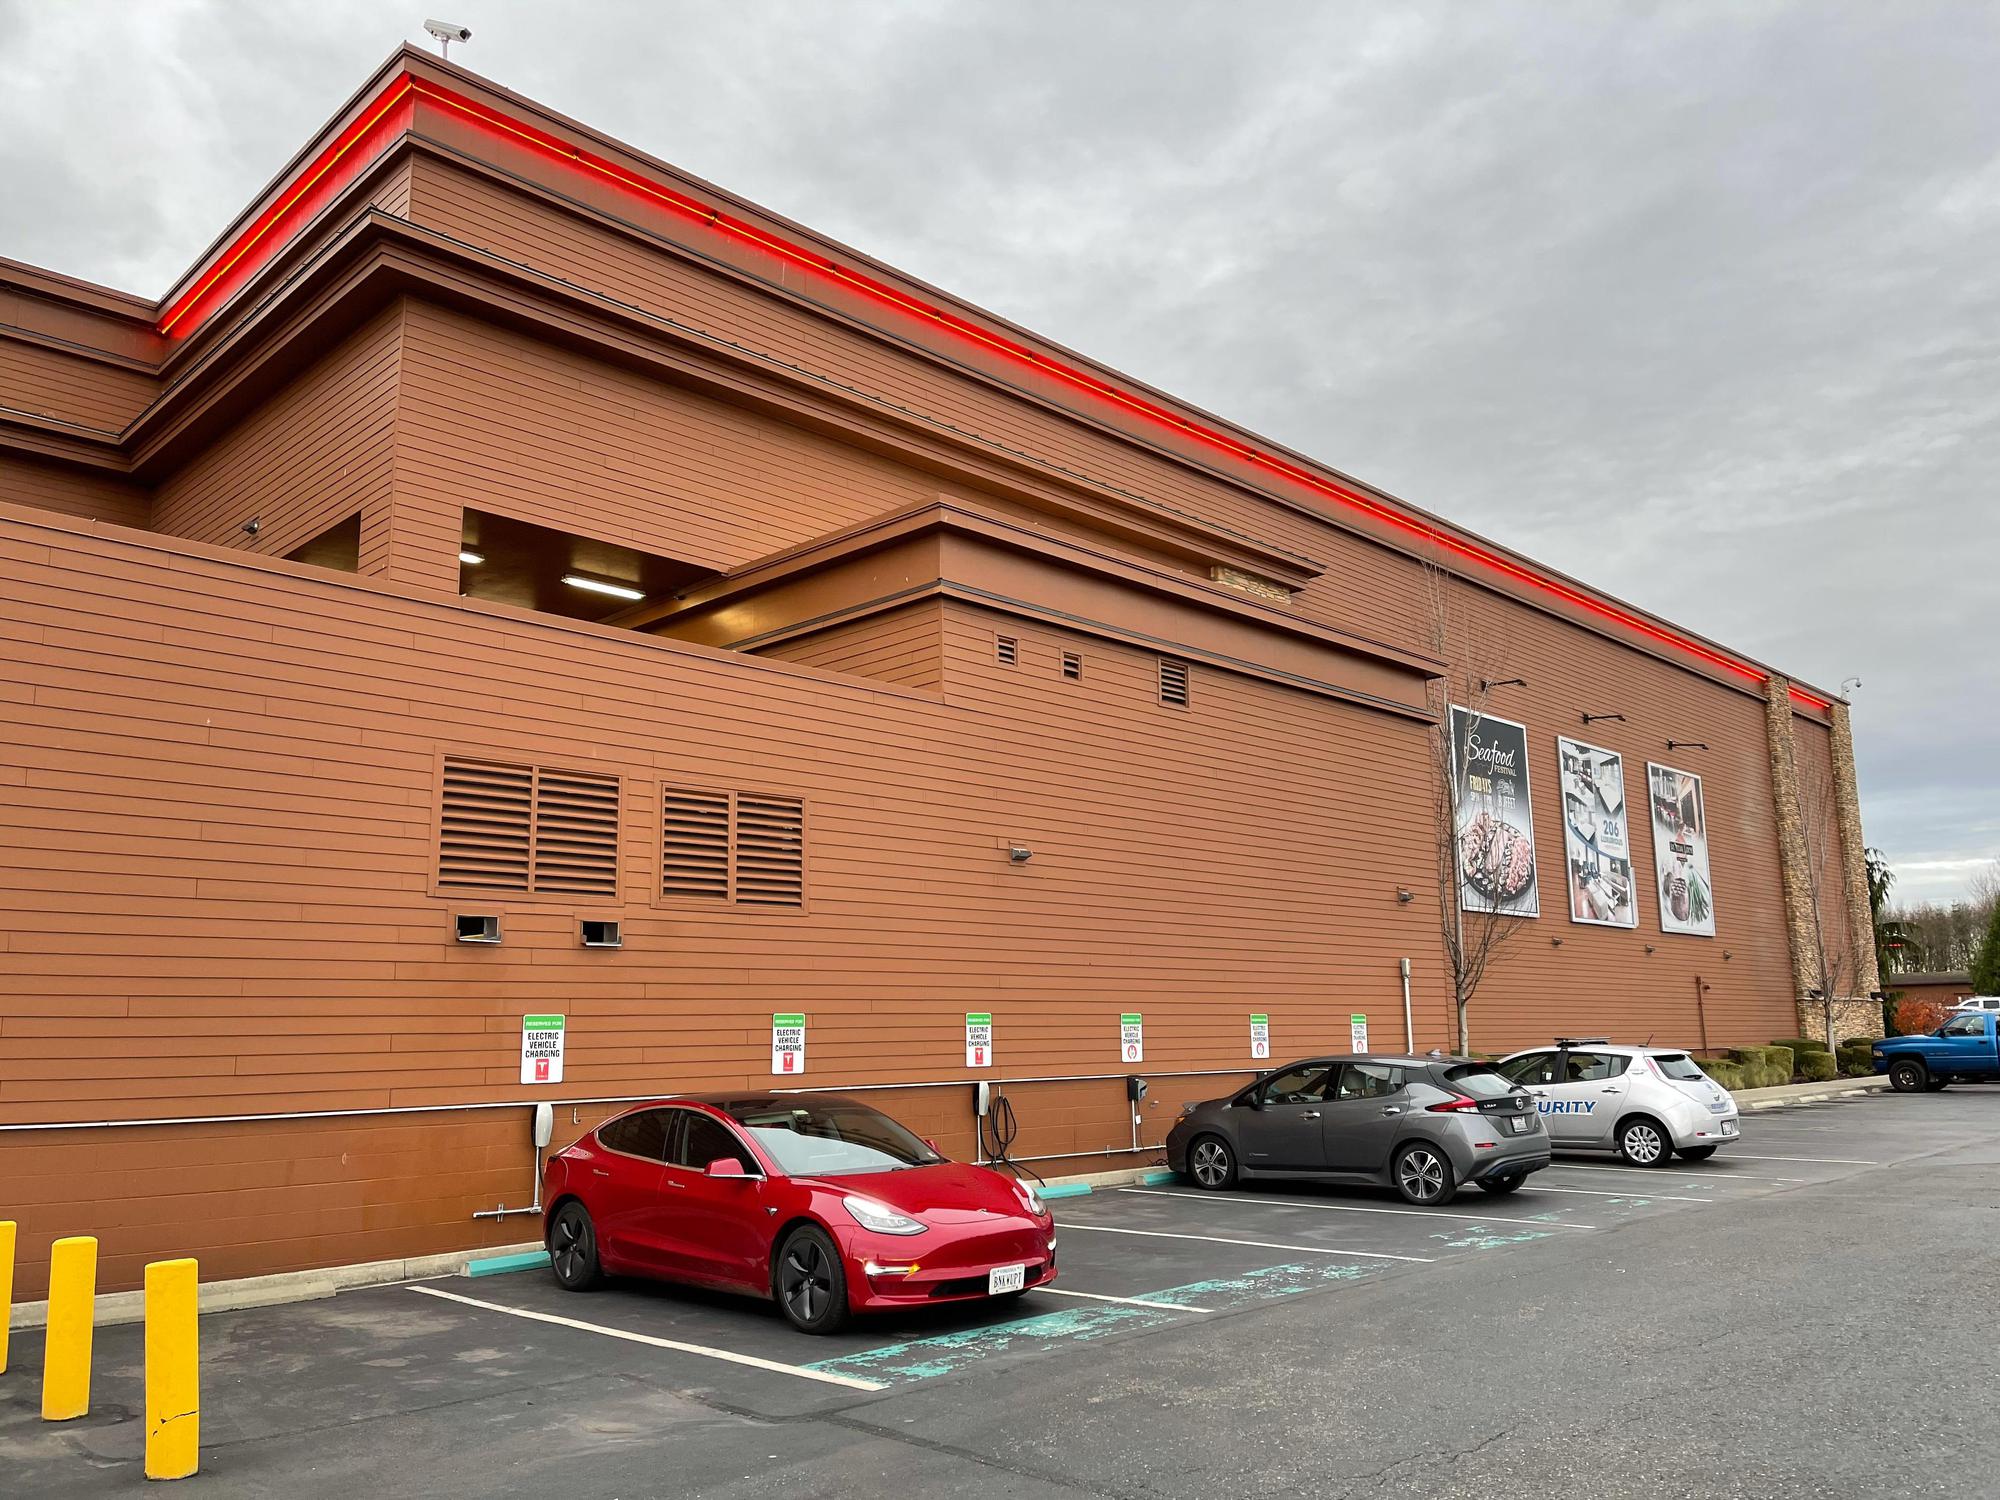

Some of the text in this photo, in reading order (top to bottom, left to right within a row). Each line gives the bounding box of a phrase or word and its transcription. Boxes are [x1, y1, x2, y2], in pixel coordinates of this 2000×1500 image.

[1468, 735, 1515, 775] Seafood
[1494, 765, 1516, 776] FESTIVAL
[1603, 820, 1619, 837] 206
[527, 1032, 559, 1040] ELECTRIC
[529, 1041, 556, 1049] VEHICLE
[525, 1050, 560, 1058] CHARGING
[1536, 1101, 1596, 1113] URITY
